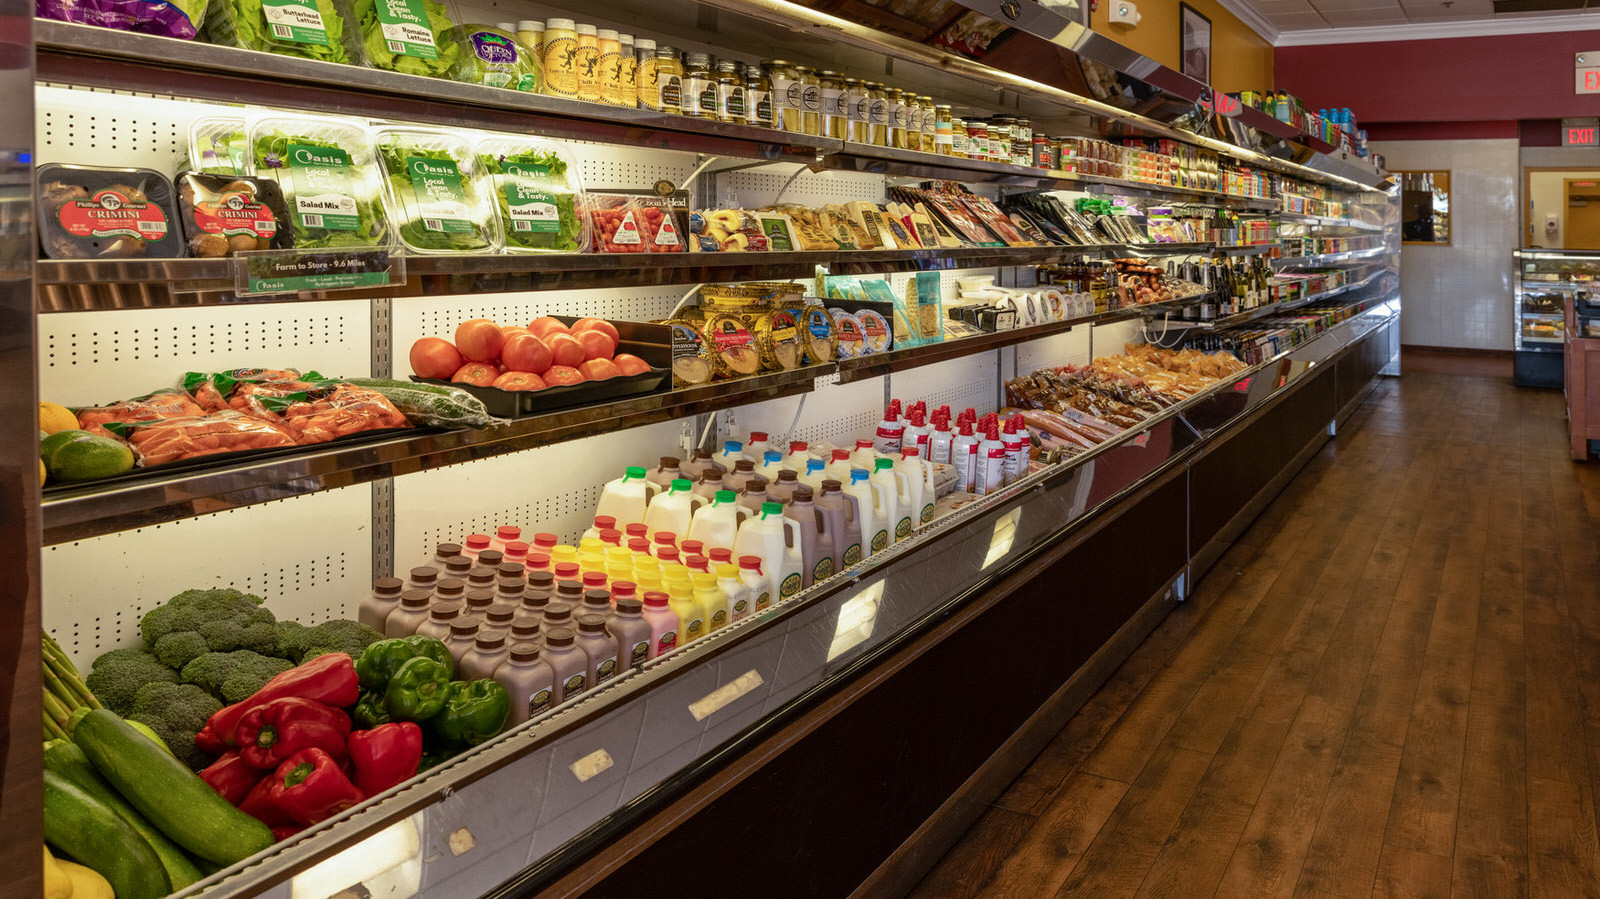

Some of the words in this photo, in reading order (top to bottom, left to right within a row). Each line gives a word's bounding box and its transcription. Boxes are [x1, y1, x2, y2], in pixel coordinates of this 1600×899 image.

[387, 3, 411, 13] Clean
[283, 9, 319, 19] Butterhead
[296, 17, 321, 25] Lettuce
[402, 26, 430, 37] Romaine
[407, 33, 432, 42] Lettuce
[1568, 128, 1595, 144] EXIT
[295, 149, 342, 164] Oasis
[305, 167, 330, 176] Local
[414, 161, 454, 174] Oasis
[423, 176, 445, 185] Local
[425, 182, 449, 191] Clean
[300, 200, 324, 209] Salad
[324, 202, 340, 210] Mix
[87, 210, 140, 219] CRIMINI
[217, 210, 258, 219] CRIMINI
[276, 263, 297, 272] Farm
[307, 261, 328, 269] Store
[333, 260, 346, 268] 9.6
[256, 280, 285, 292] Oasis
